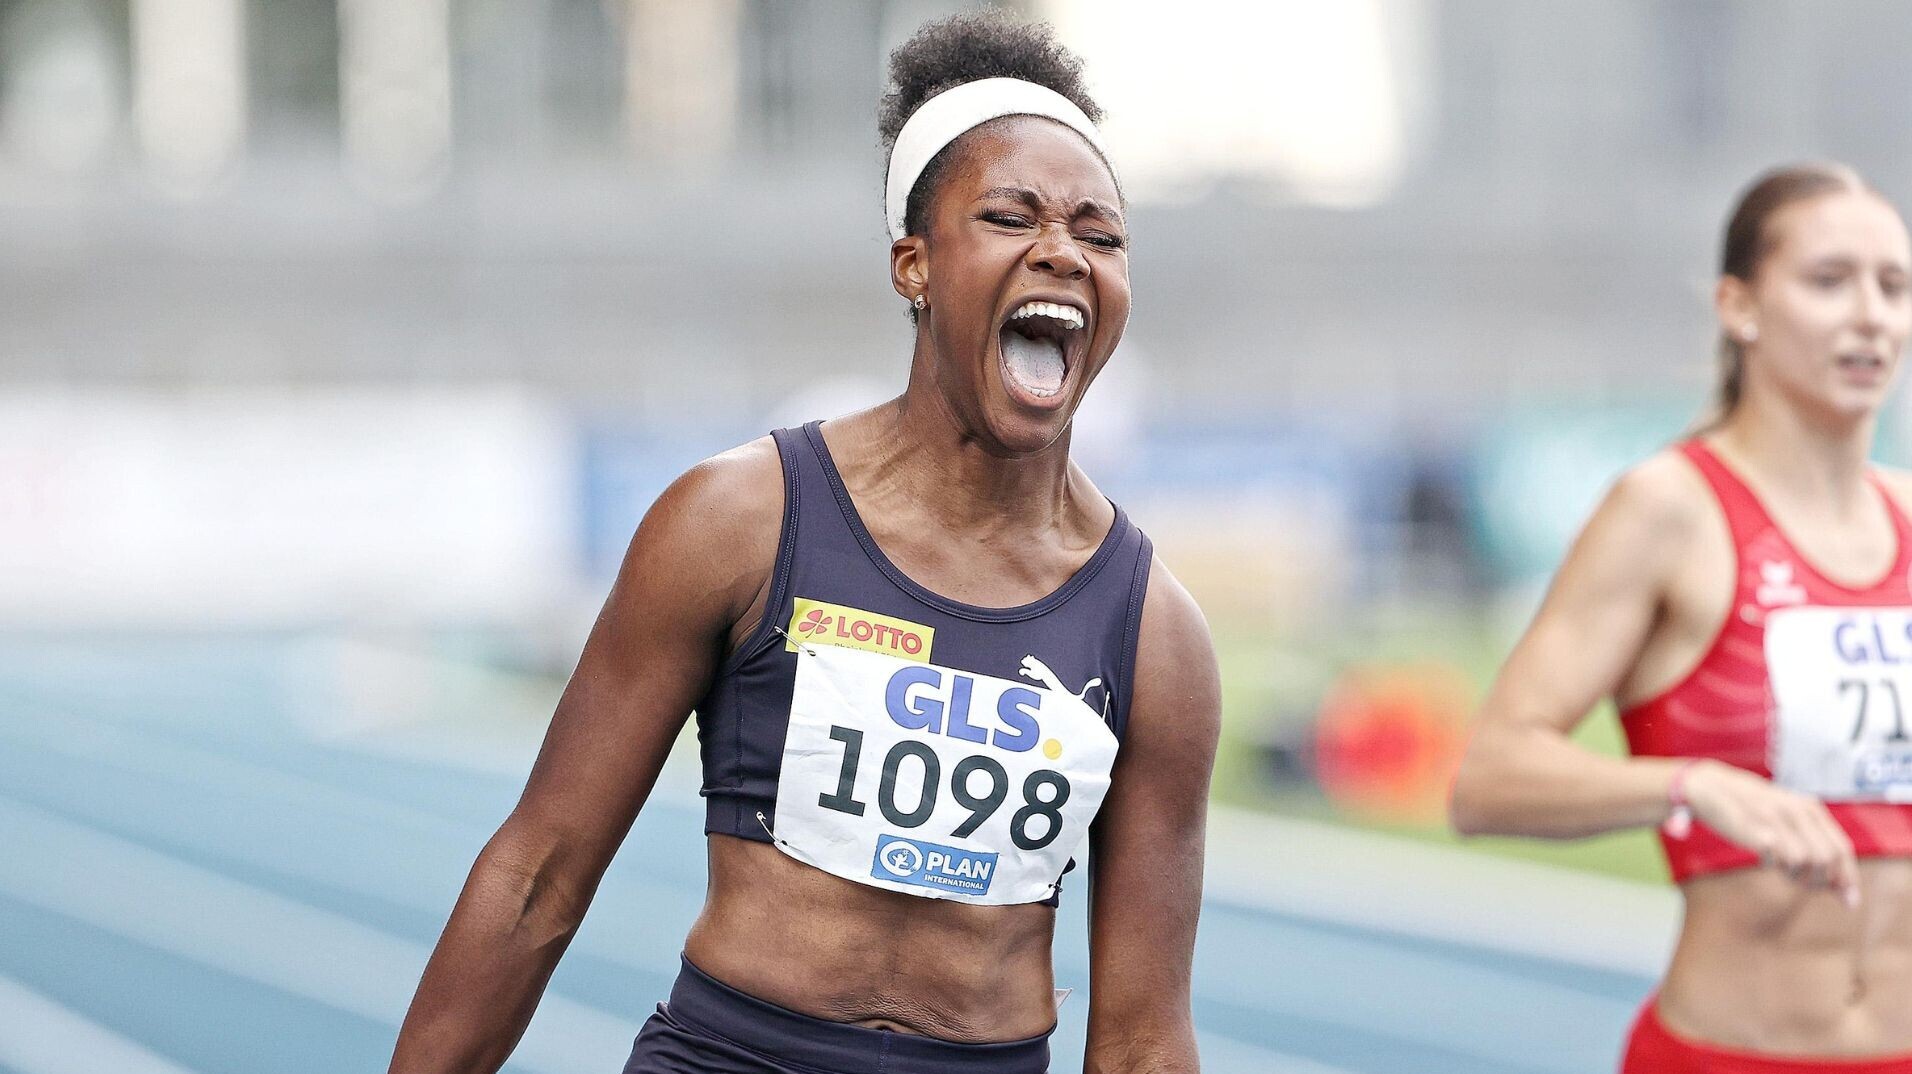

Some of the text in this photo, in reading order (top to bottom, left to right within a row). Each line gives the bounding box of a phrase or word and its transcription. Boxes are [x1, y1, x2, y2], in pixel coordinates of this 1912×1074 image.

[837, 616, 922, 654] LOTTO
[818, 725, 1070, 850] 1098
[924, 873, 984, 890] INTERNATIONAL
[926, 851, 991, 880] PLAN
